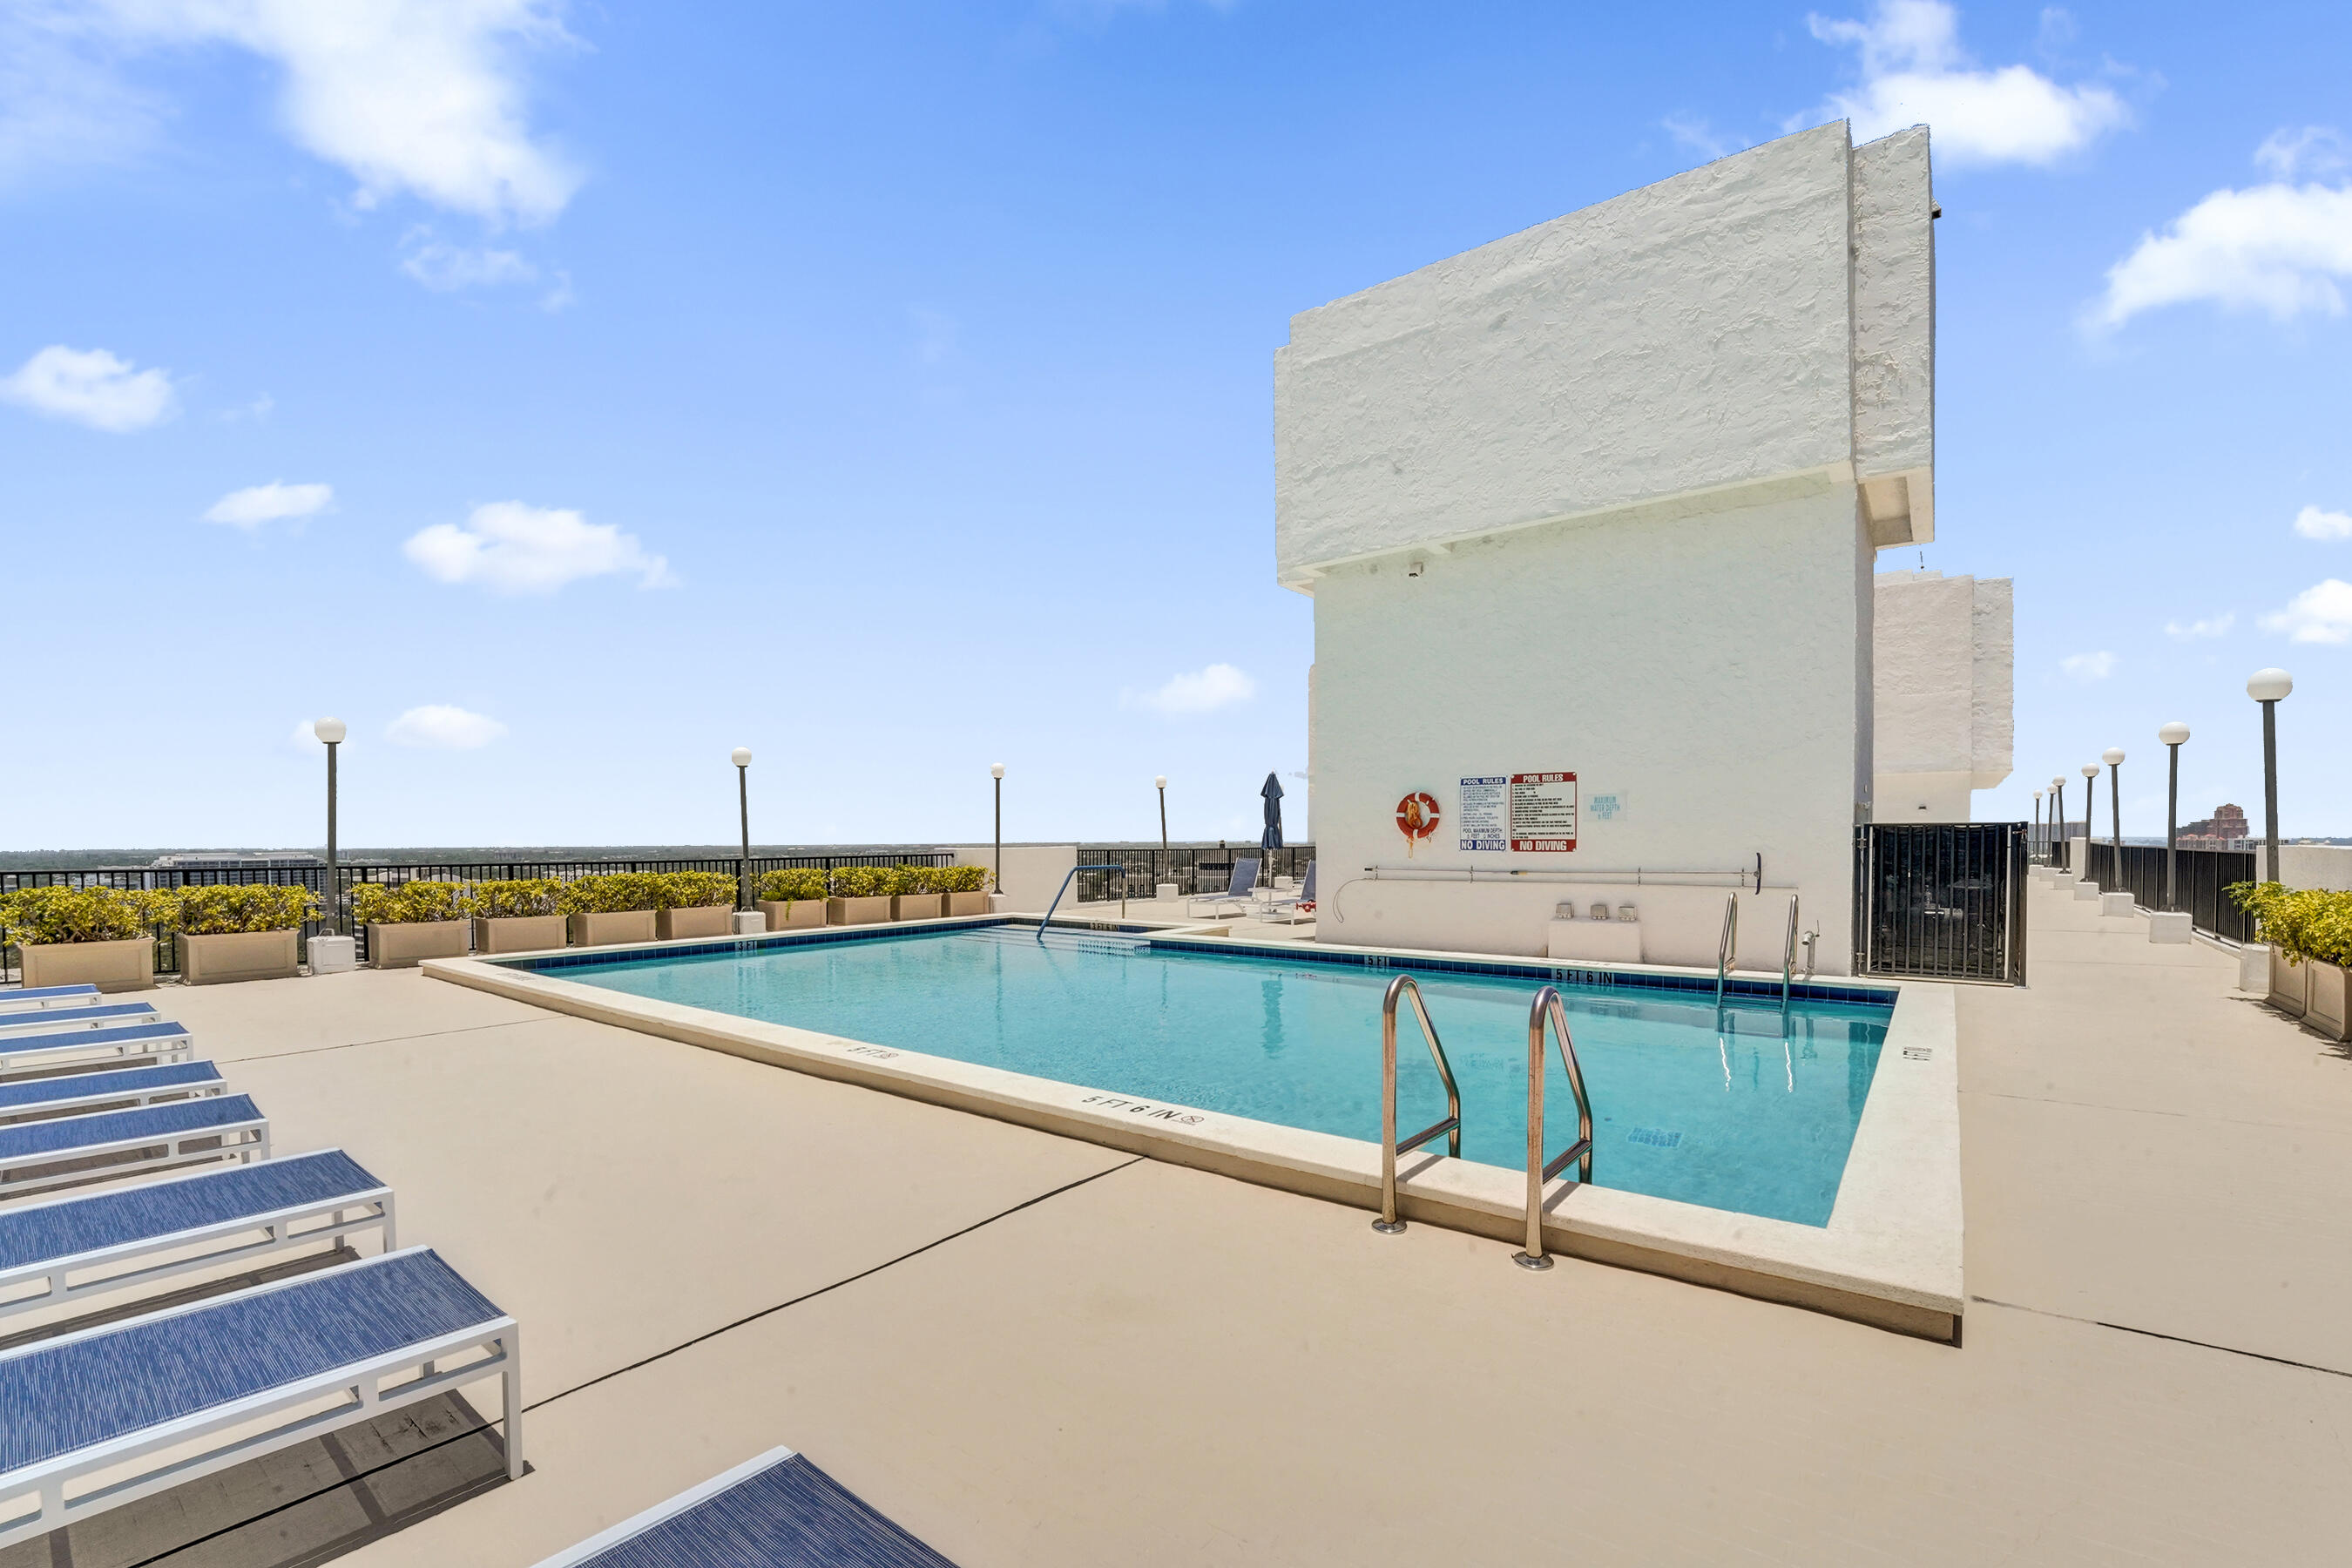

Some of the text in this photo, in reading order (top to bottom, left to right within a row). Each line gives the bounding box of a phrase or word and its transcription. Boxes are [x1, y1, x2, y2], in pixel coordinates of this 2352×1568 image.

[1523, 774, 1564, 783] POOL RULES
[1461, 840, 1505, 850] NO DIVING
[1519, 840, 1567, 851] NO DIVING
[739, 940, 754, 950] 3 FT
[1368, 955, 1387, 967] 5 FT
[1556, 969, 1612, 983] 5 FT 6 IN
[1098, 1098, 1132, 1108] FT
[1147, 1109, 1181, 1119] IN
